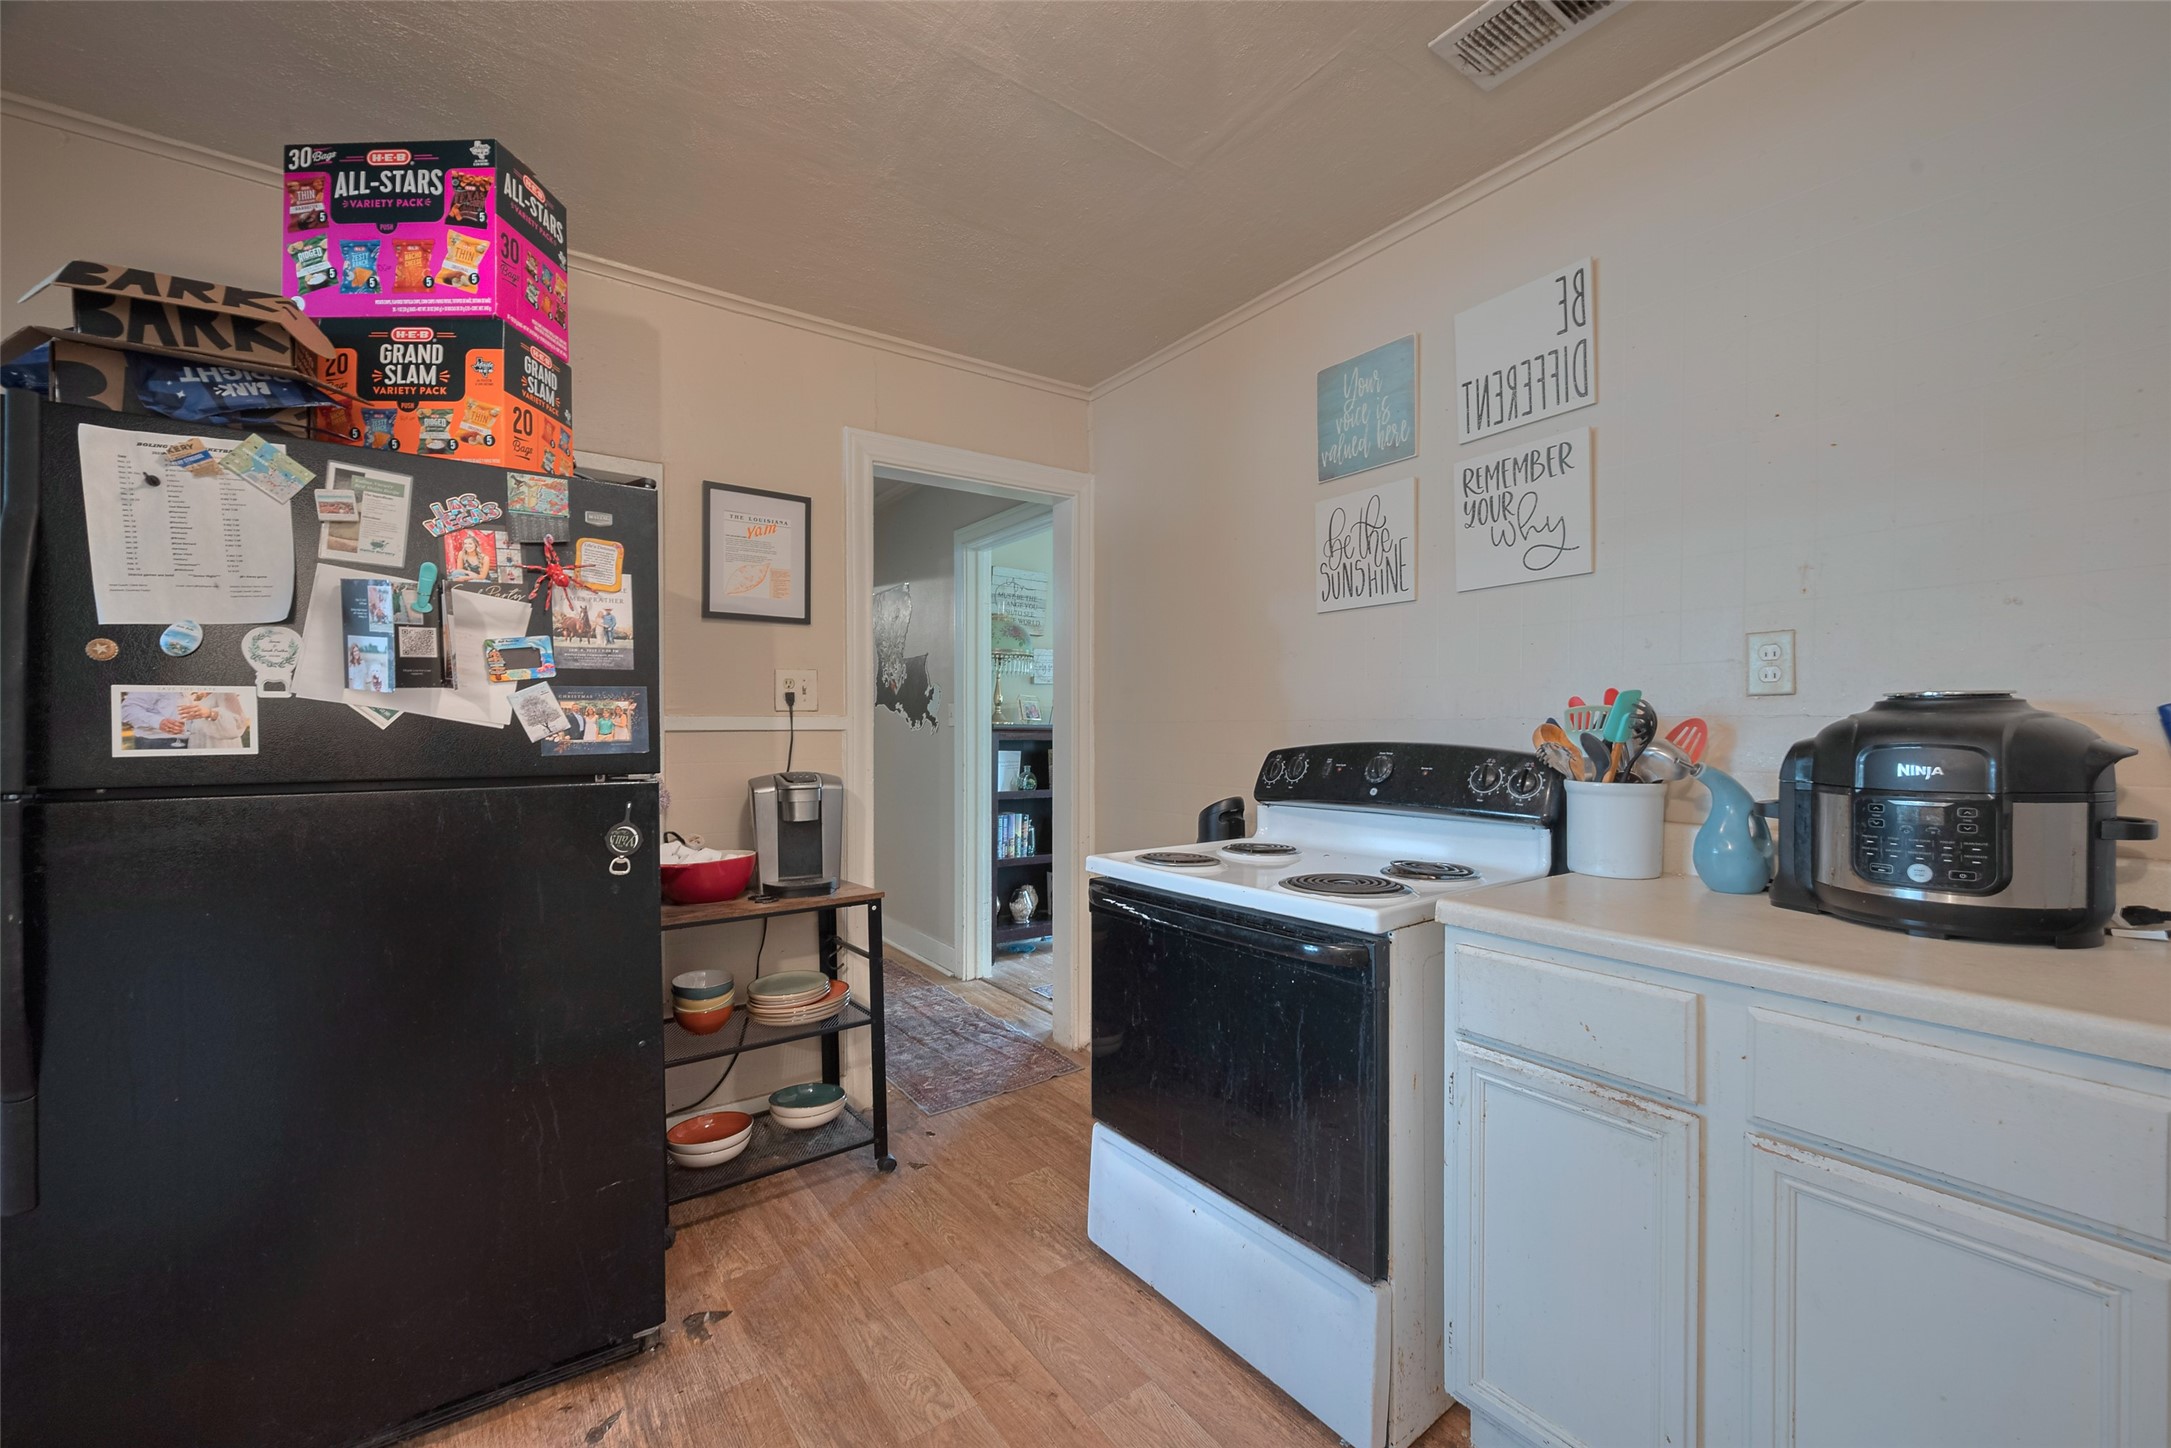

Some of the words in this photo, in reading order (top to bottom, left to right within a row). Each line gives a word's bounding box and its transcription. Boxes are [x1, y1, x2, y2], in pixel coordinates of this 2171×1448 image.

[288, 147, 312, 170] 30
[312, 151, 337, 162] Bags
[334, 169, 443, 198] ALL-STARS
[296, 189, 316, 201] THIN
[349, 199, 393, 208] VARIETY
[396, 199, 421, 207] PACK
[319, 212, 326, 222] 5
[479, 212, 486, 222] 5
[504, 173, 564, 244] ALL-STARS
[513, 205, 538, 230] VARIETY
[539, 227, 555, 244] PACK
[298, 247, 322, 262] RIDGED
[351, 252, 370, 261] ZESTY
[456, 247, 475, 262] THIN
[501, 232, 519, 264] 30
[329, 269, 336, 279] 5
[369, 278, 376, 288] 5
[426, 277, 432, 287] 5
[471, 273, 478, 283] 5
[501, 263, 519, 283] Bags
[55, 260, 285, 313] BARK
[74, 286, 290, 354] BARK
[379, 343, 444, 364] GRAND
[325, 353, 348, 377] 20
[384, 364, 437, 386] SLAM
[524, 355, 557, 391] GRAND
[373, 386, 416, 395] VARIETY
[419, 387, 447, 395] PACK
[527, 376, 555, 407] SLAM
[1343, 367, 1383, 409] Your
[522, 389, 545, 408] VARIETY
[545, 401, 559, 416] PACK
[1376, 396, 1392, 425] is
[424, 418, 446, 427] RIDGED
[471, 411, 489, 424] THIN
[513, 406, 533, 436] 20
[352, 429, 358, 439] 5
[486, 435, 493, 445] 5
[1321, 424, 1371, 467] valued
[1377, 420, 1411, 450] here
[392, 440, 398, 449] 5
[450, 440, 456, 449] 5
[513, 439, 533, 456] Bags
[1463, 441, 1576, 498] REMEMBER
[430, 493, 480, 518] LAS
[1463, 490, 1516, 529] YOUR
[423, 502, 502, 537] VEGAS
[748, 516, 789, 526] LOUISIANA
[1350, 494, 1394, 567] the
[1320, 536, 1410, 602] SUNSHINE
[1897, 763, 1944, 780] NINJA
